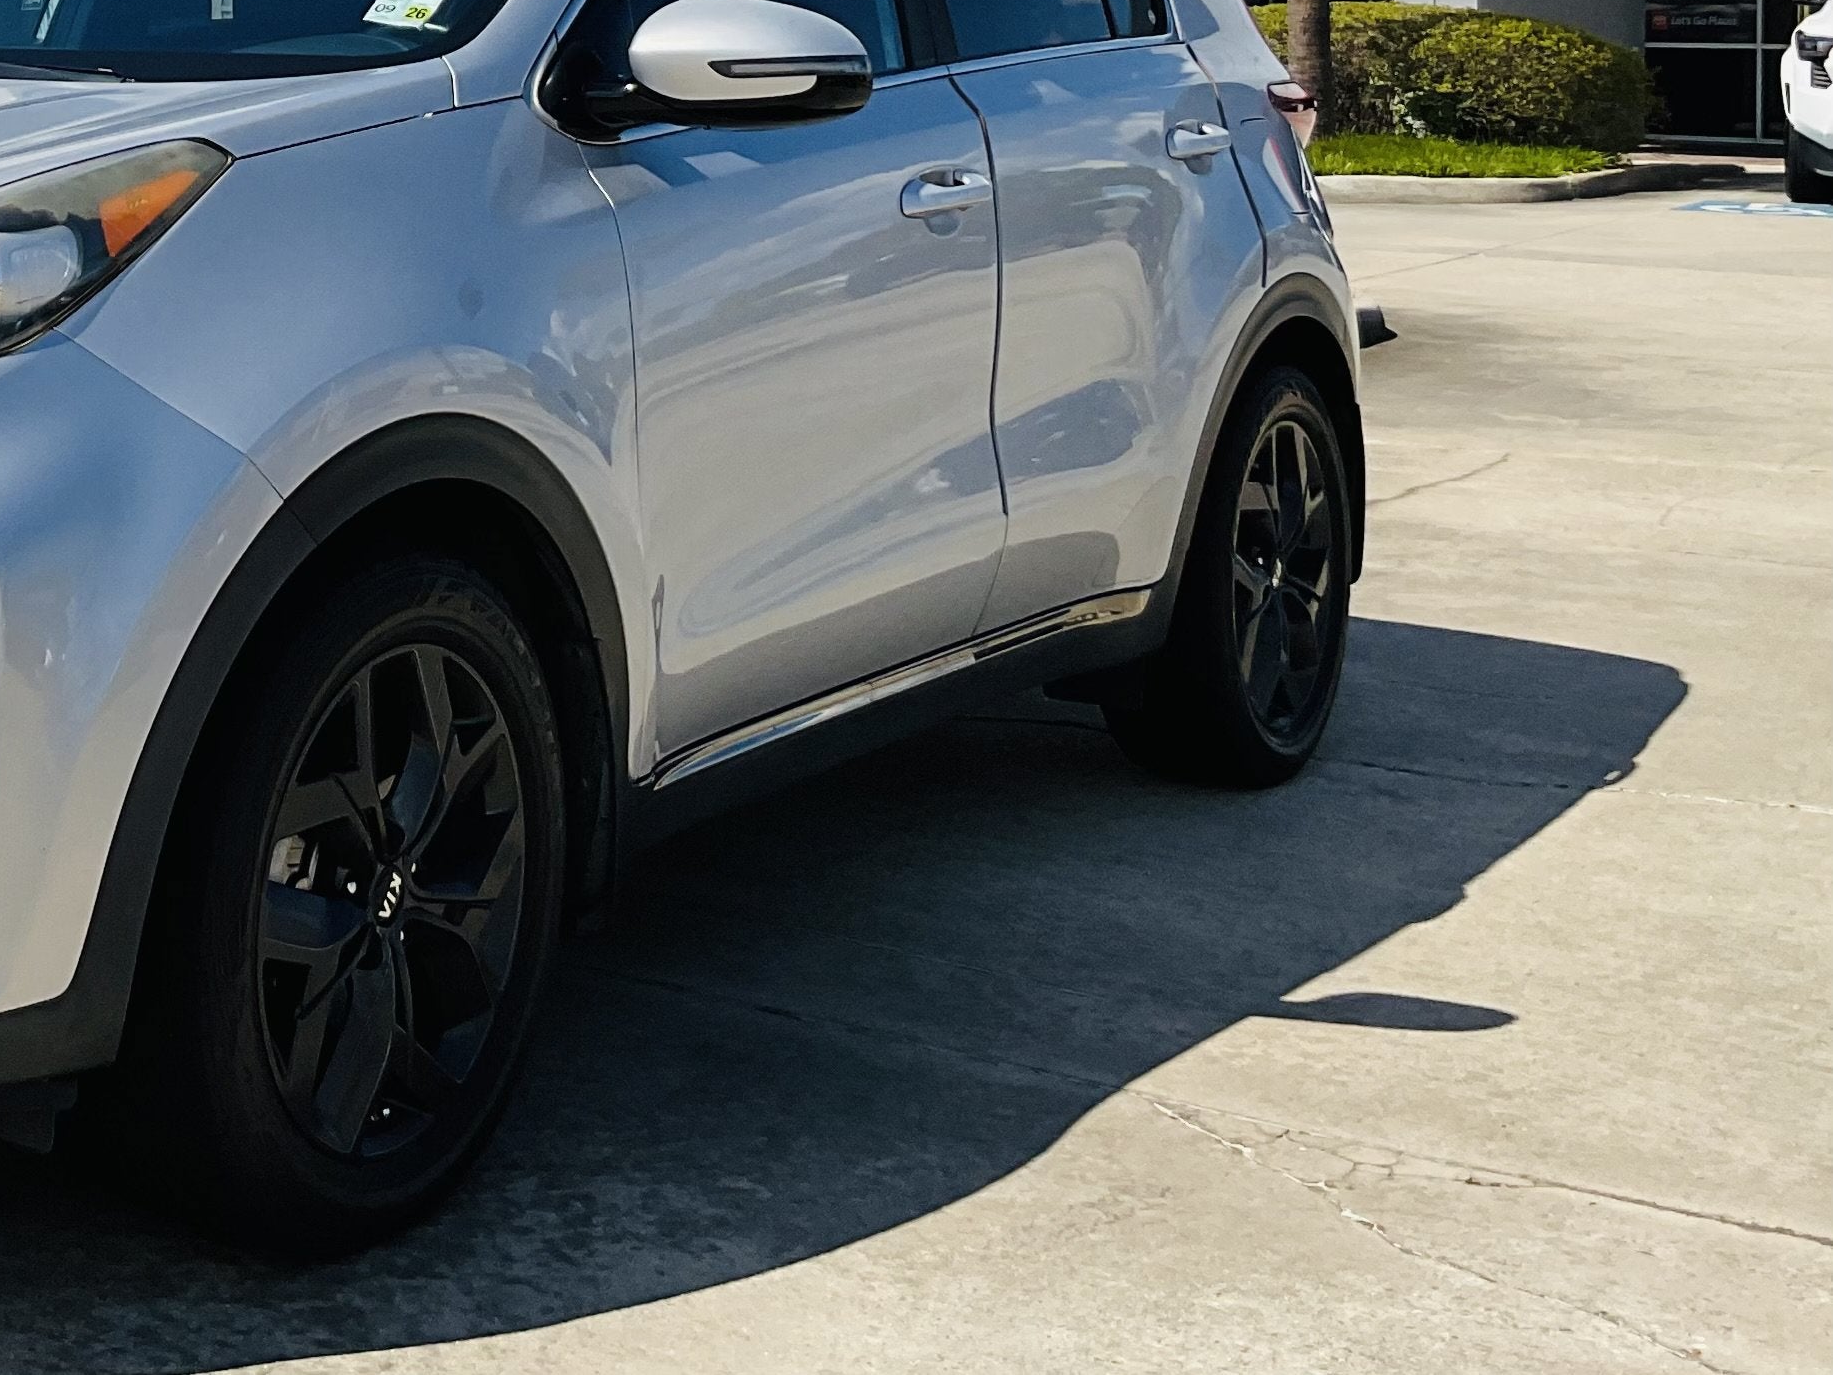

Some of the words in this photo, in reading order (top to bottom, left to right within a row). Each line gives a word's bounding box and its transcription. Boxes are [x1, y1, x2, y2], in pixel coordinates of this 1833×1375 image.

[374, 3, 396, 13] 09
[405, 7, 428, 19] 26
[378, 871, 402, 918] KIA
